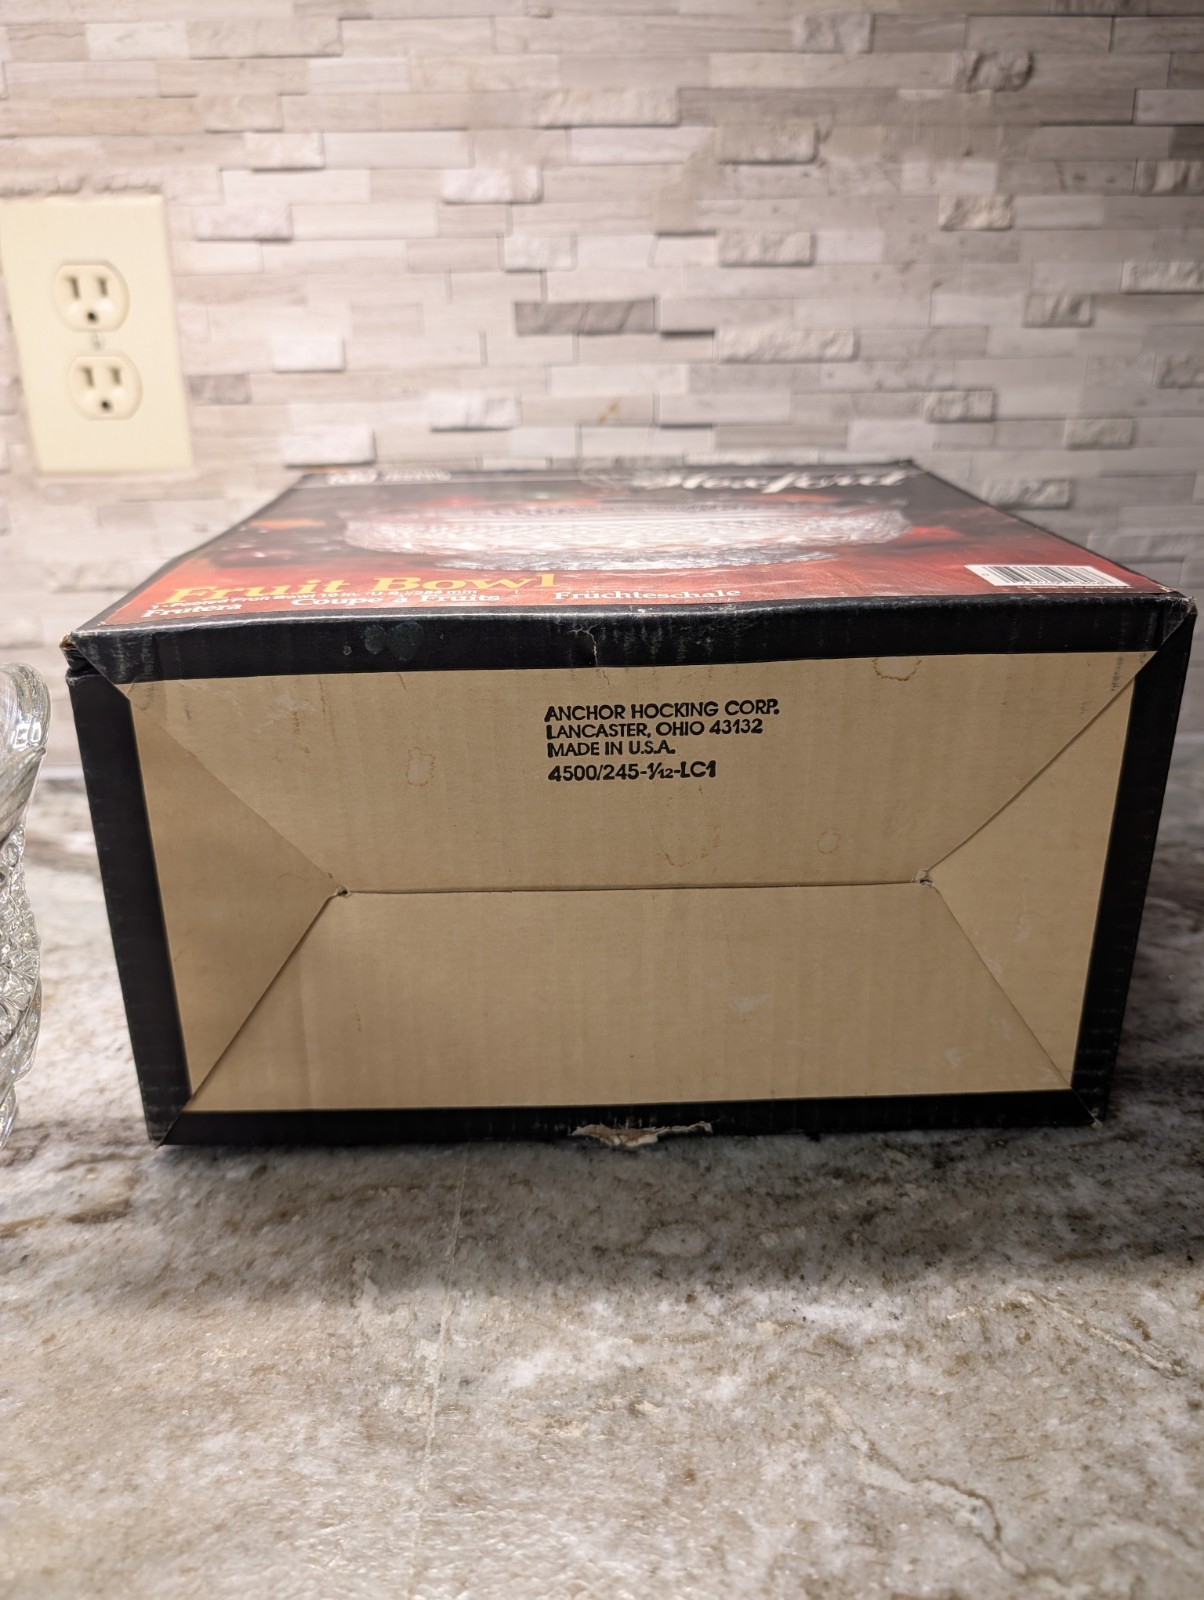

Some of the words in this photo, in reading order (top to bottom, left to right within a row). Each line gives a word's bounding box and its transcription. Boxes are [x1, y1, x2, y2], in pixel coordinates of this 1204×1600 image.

[157, 579, 351, 604] Fruit
[369, 573, 558, 592] Bowl
[141, 603, 242, 618] Frutera
[290, 597, 384, 606] Coupe
[420, 594, 501, 602] Fruits
[553, 589, 742, 600] Früchteschale
[544, 704, 626, 722] ANCHOR
[631, 701, 719, 719] HOCKING
[724, 698, 780, 716] CORP.
[546, 722, 651, 740] LANCASTER,
[655, 720, 705, 736] OHIO
[709, 718, 763, 735] 43132
[547, 741, 600, 758] MADE
[604, 740, 623, 755] IN
[628, 739, 676, 755] U.S.A.
